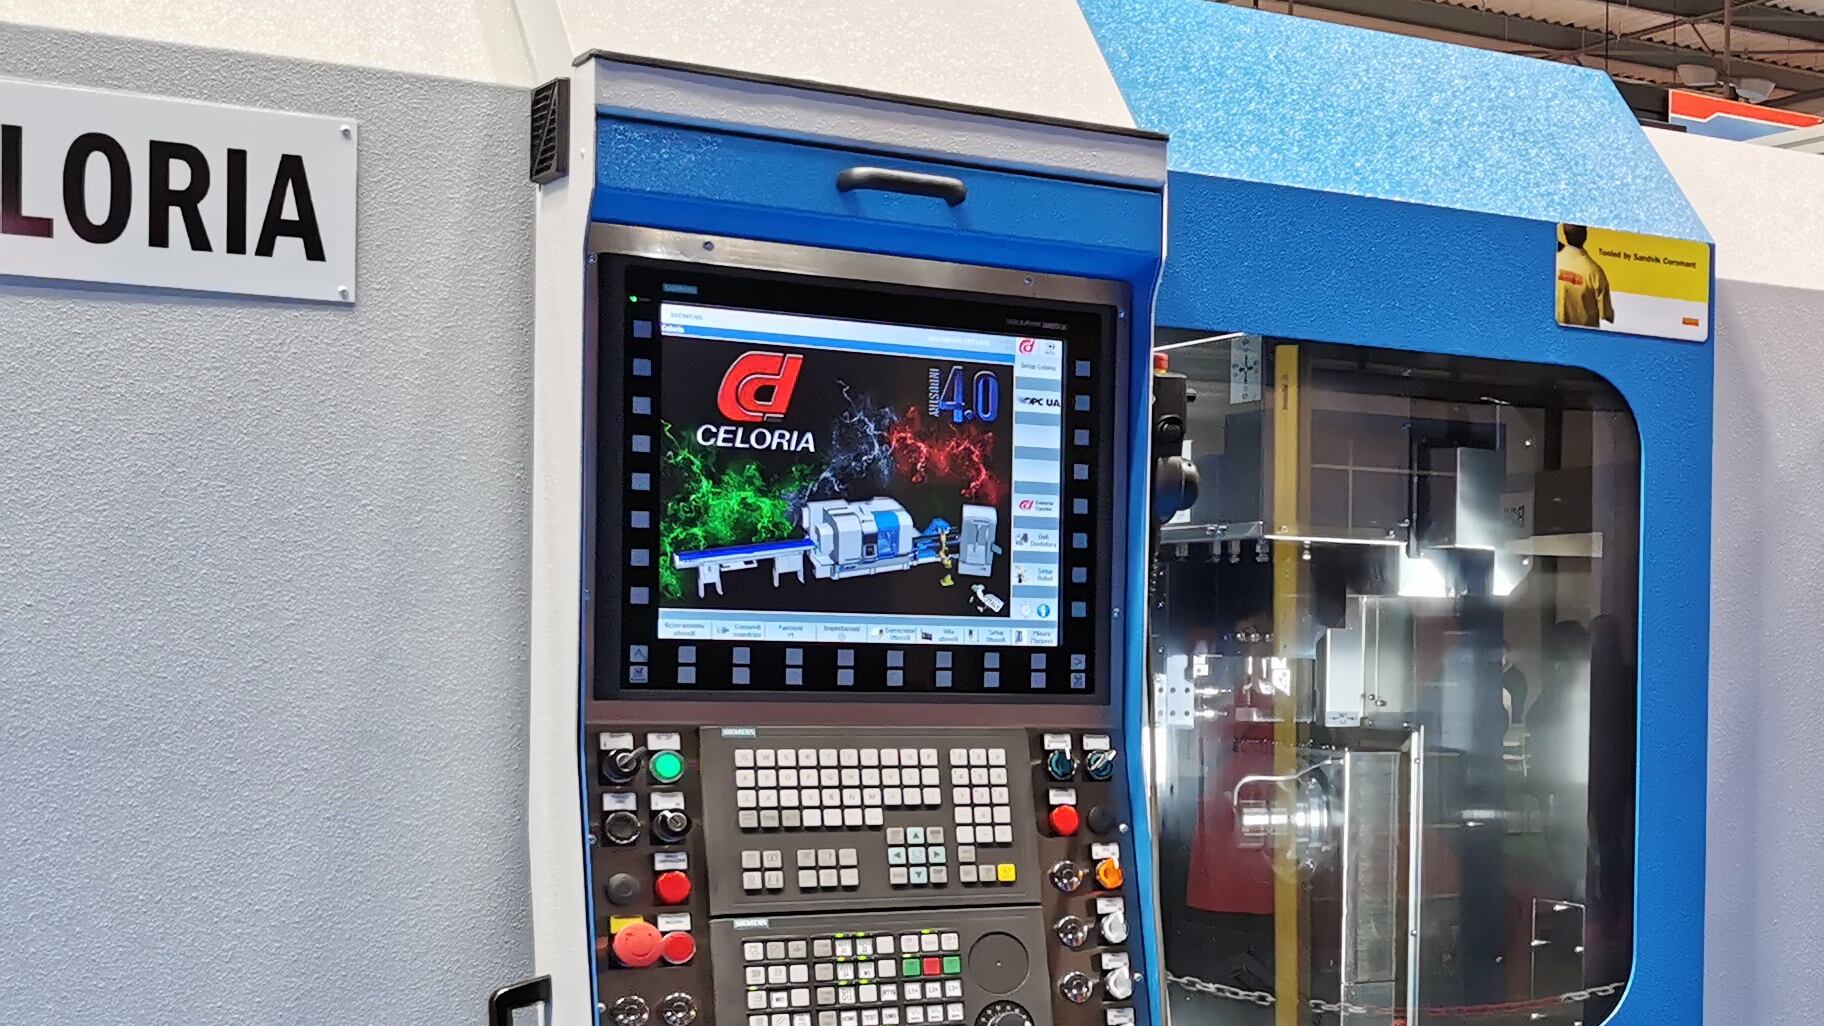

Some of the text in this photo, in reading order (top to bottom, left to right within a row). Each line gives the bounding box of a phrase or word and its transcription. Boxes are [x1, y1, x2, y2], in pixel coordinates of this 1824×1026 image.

[1, 124, 326, 262] LORIA
[1598, 247, 1697, 269] Tooled by Sandvik Coromant
[928, 367, 940, 418] INDUSTRY
[1046, 398, 1060, 407] UA
[696, 424, 816, 453] CELORIA
